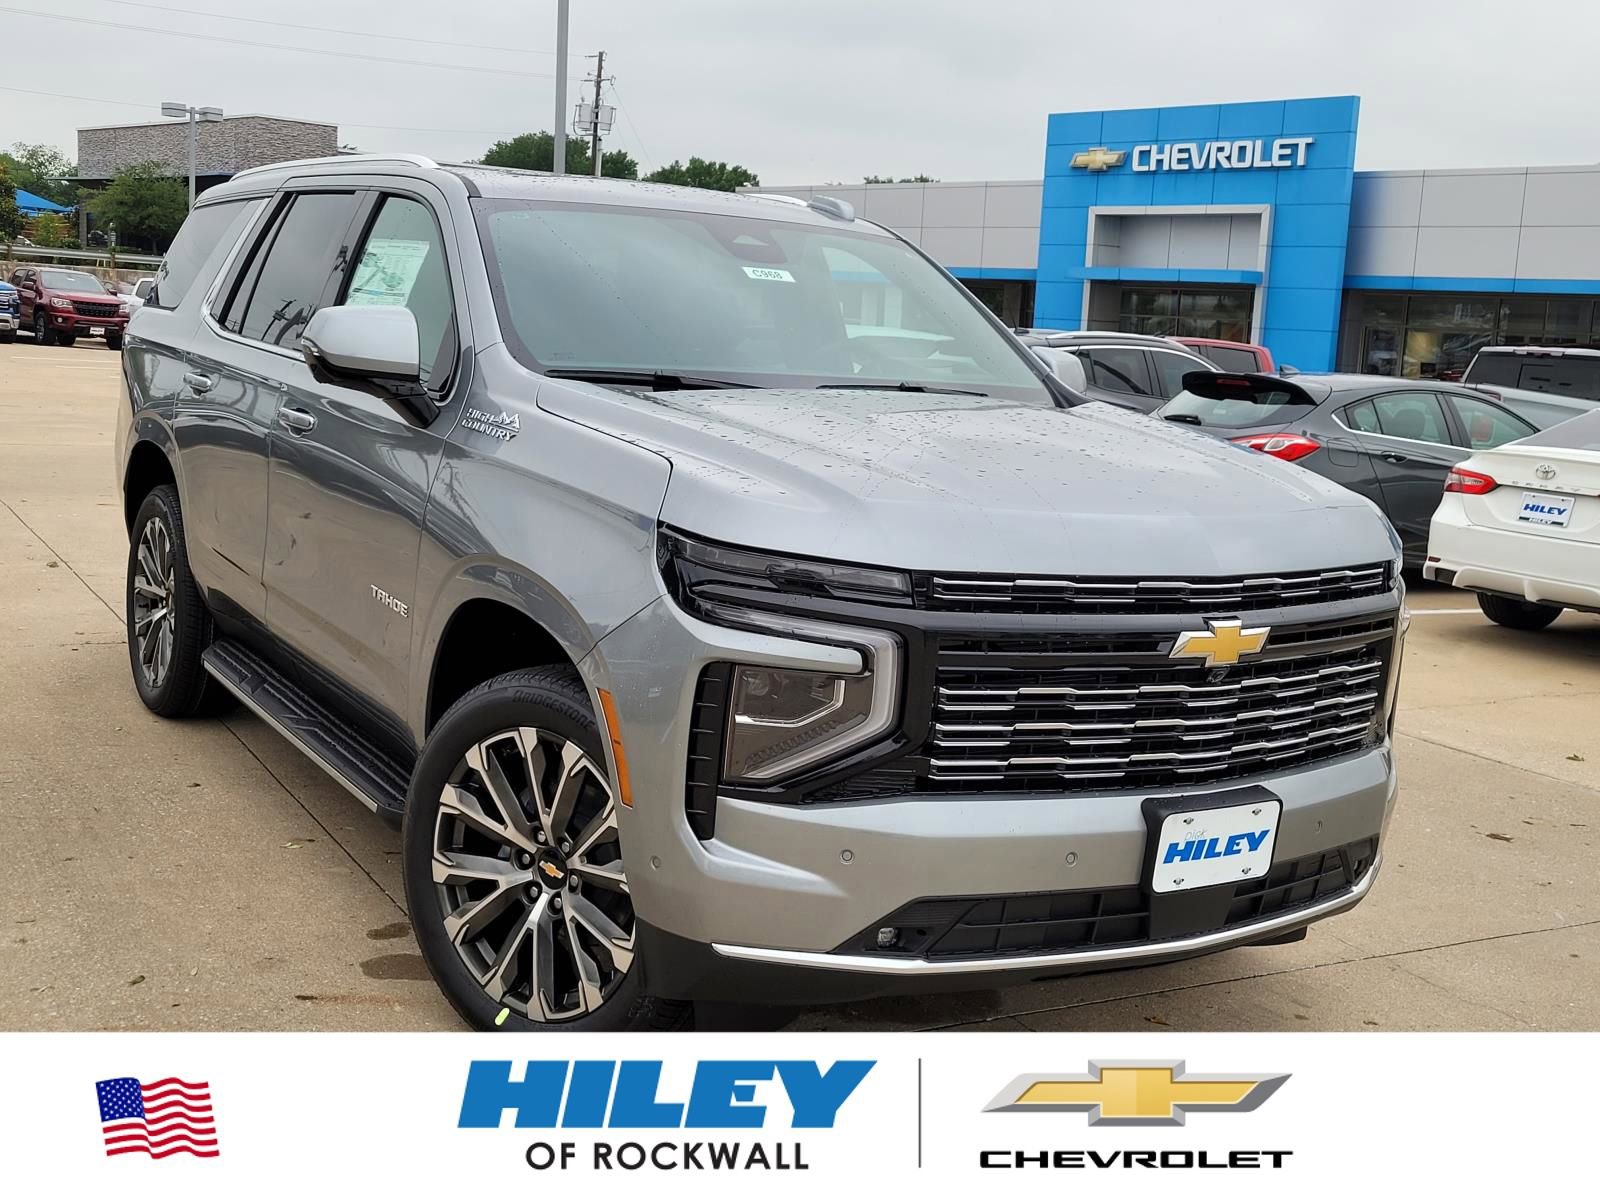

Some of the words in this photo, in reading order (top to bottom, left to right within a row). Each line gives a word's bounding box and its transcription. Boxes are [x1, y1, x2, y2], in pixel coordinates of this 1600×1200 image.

[1131, 137, 1314, 173] CHEVROLET
[461, 418, 517, 441] COUNTRY
[466, 408, 495, 423] HIGH
[1523, 503, 1567, 516] HILEY
[370, 584, 409, 618] TAHOE
[513, 690, 595, 729] BRIDGESTONE
[1163, 829, 1271, 864] HILEY
